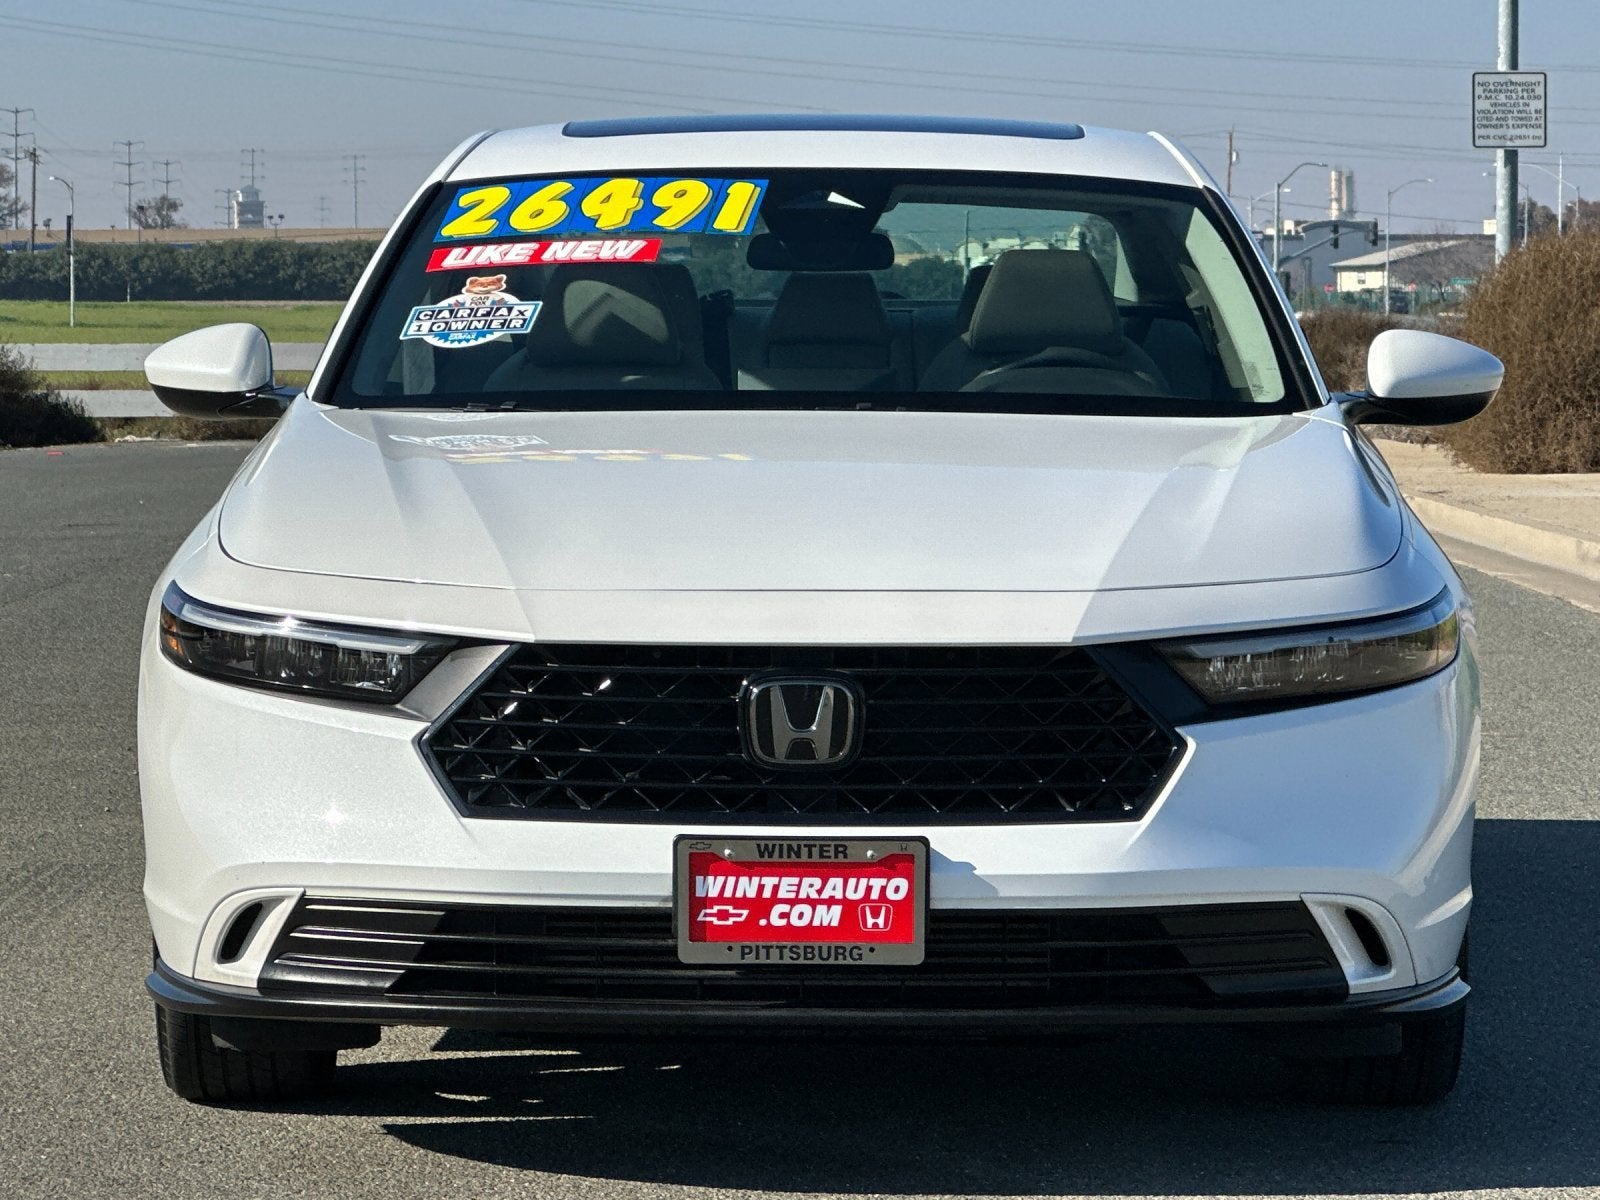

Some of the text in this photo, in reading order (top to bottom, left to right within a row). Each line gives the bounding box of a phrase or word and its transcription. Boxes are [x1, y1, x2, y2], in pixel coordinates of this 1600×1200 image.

[440, 178, 761, 237] 26491
[441, 239, 646, 268] LIKE NEW
[418, 307, 528, 320] CARFAX
[413, 318, 524, 332] 1 OWNER
[756, 844, 848, 859] WINTER
[695, 876, 908, 900] WINTERAUTO
[759, 904, 842, 926] .COM
[740, 946, 863, 961] PITTSBURG
